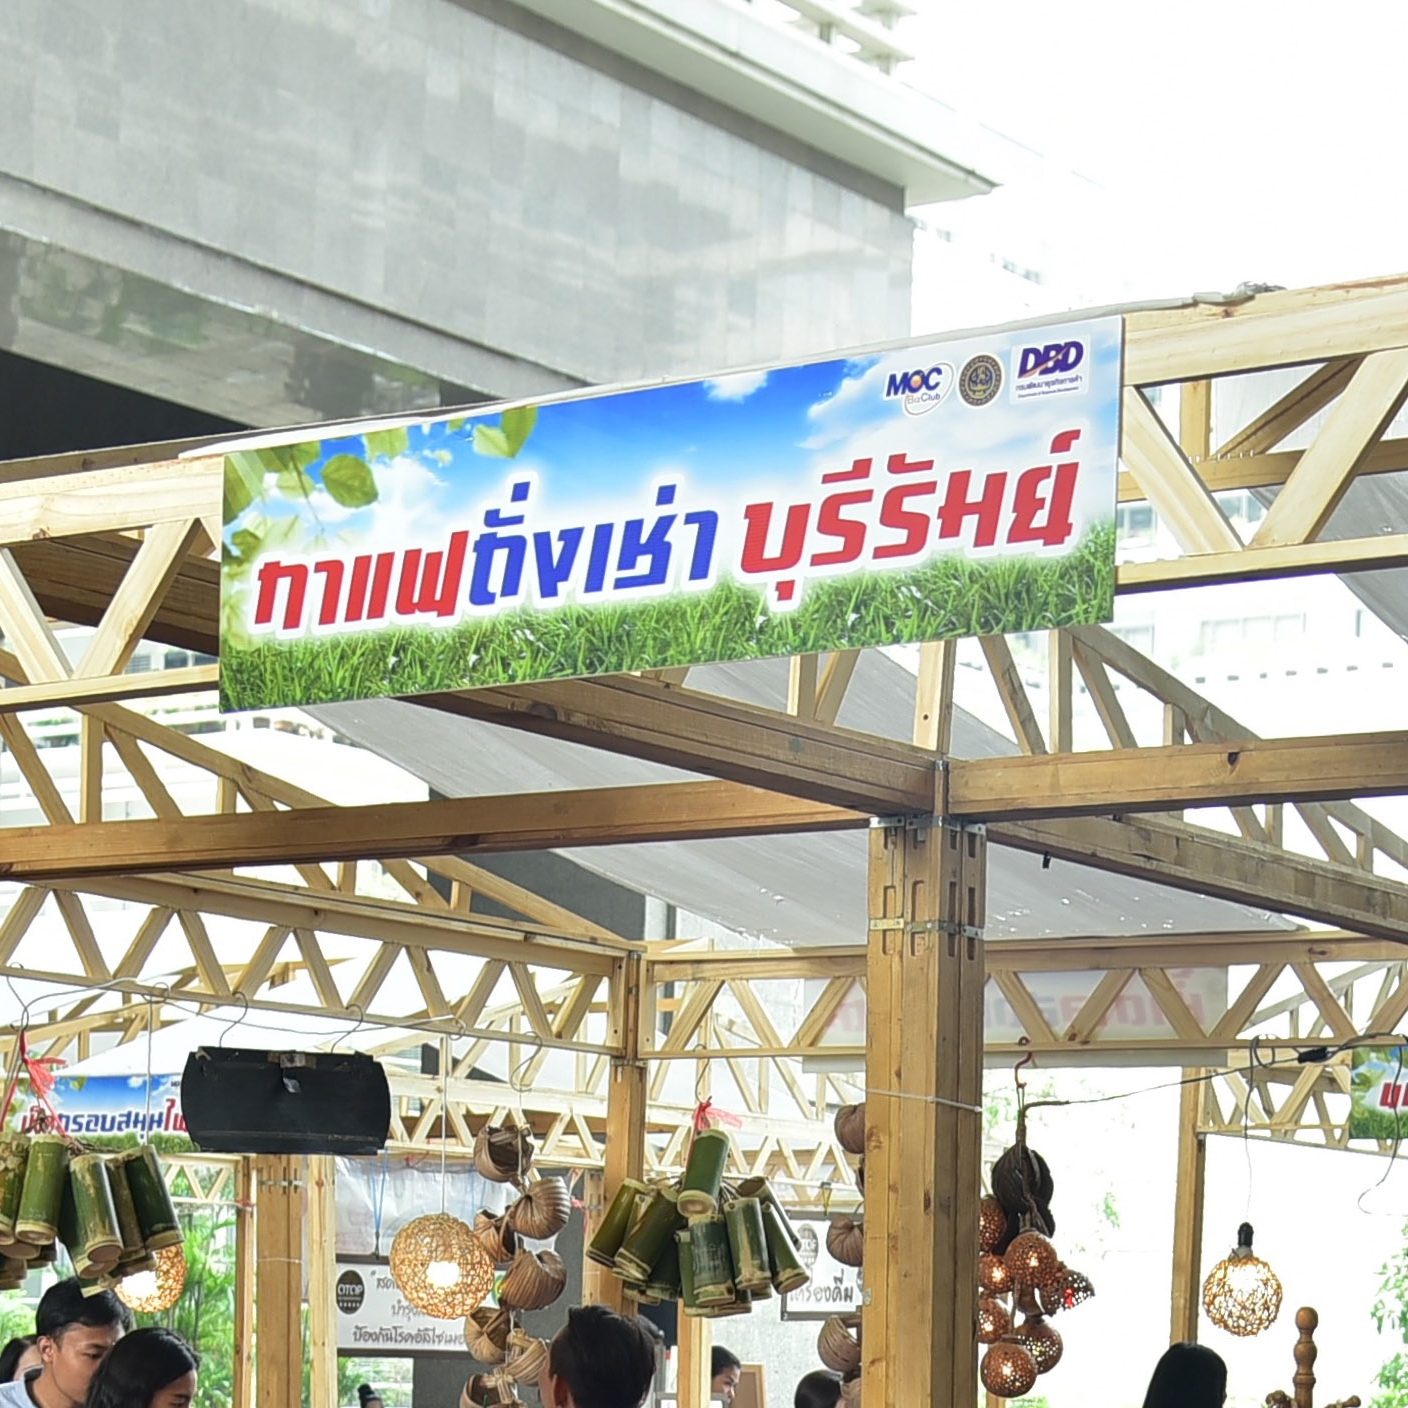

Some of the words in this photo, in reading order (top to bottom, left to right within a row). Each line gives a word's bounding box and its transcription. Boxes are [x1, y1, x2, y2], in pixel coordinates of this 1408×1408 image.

[1017, 340, 1084, 379] DBD
[886, 366, 942, 397] MOC
[255, 480, 720, 630] กาแฟถั่งเช่า
[740, 428, 1082, 593] บุรีรัมย์
[337, 1283, 363, 1296] OTOP
